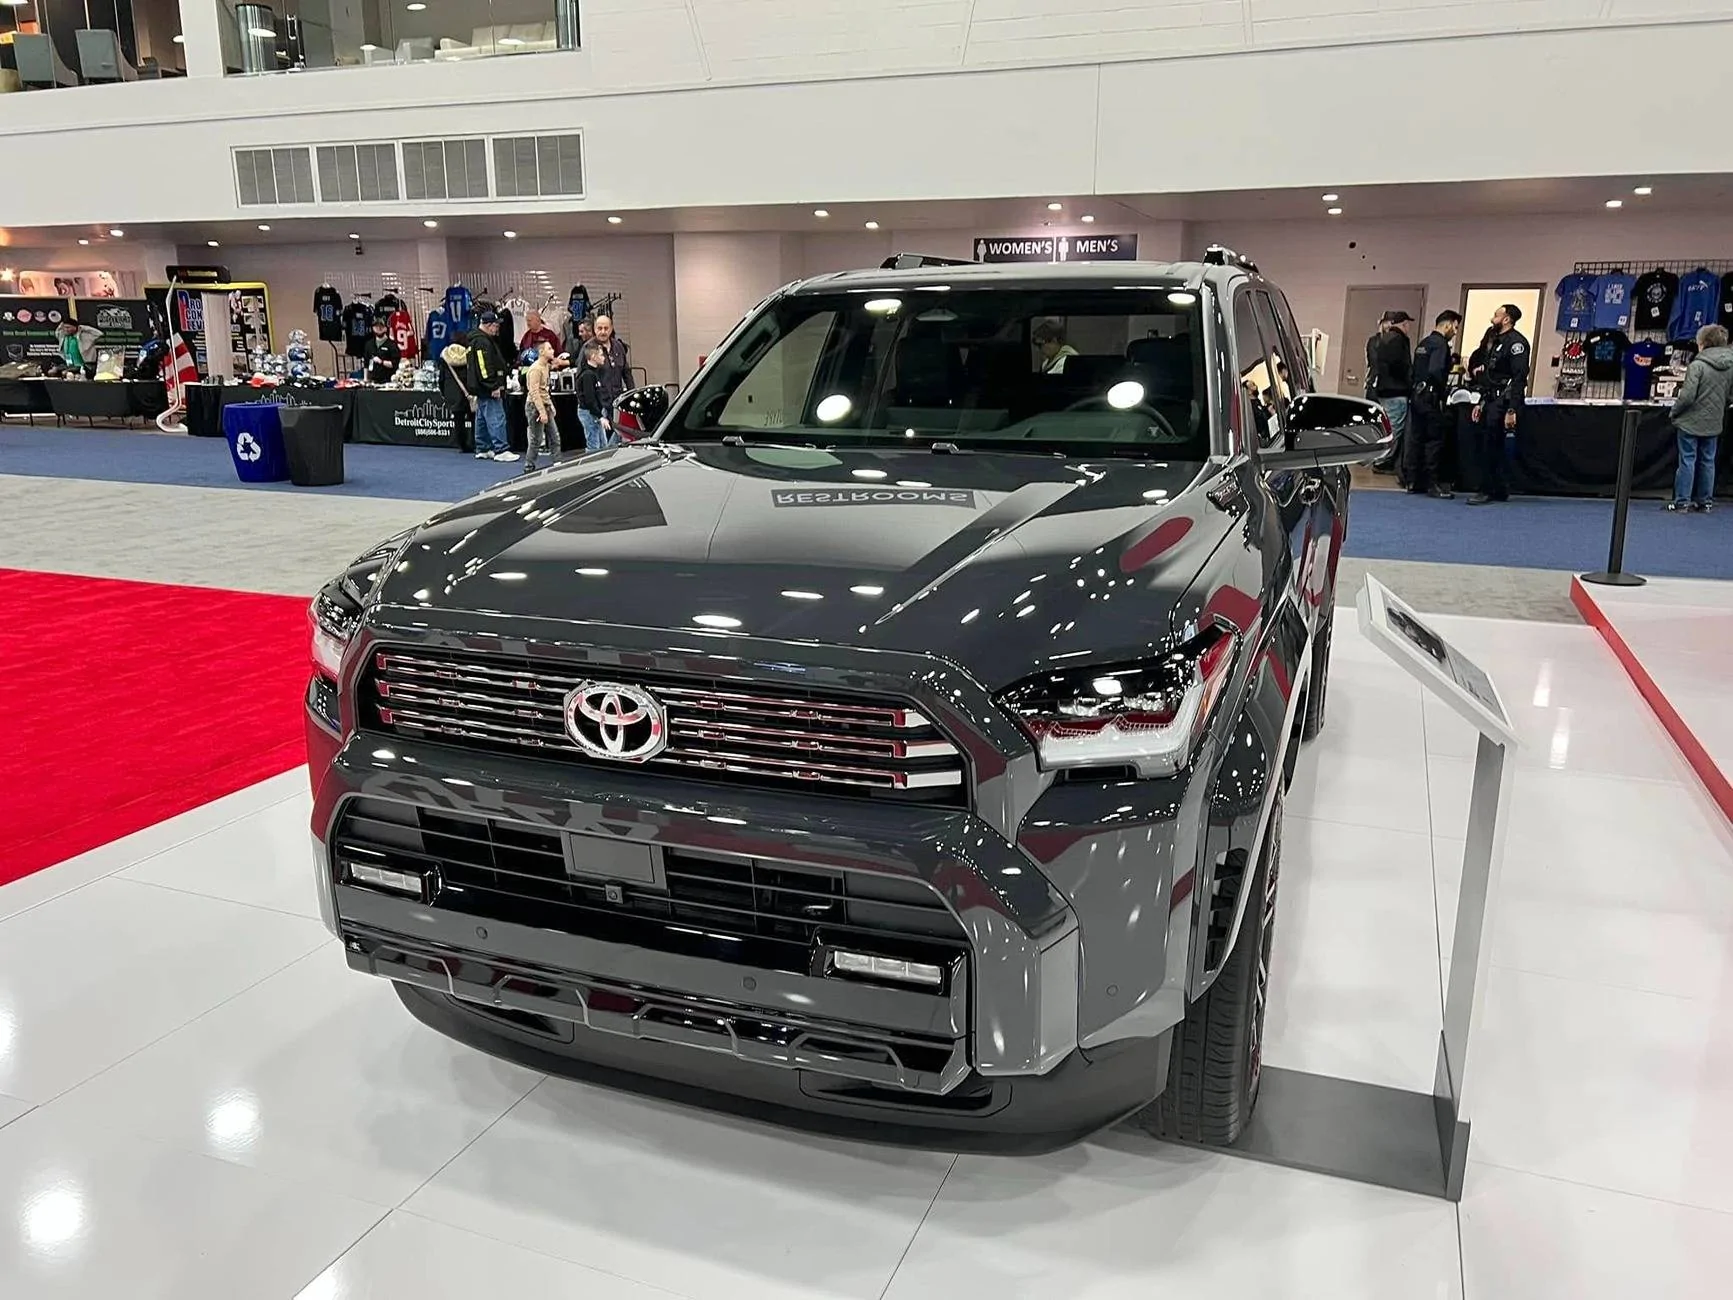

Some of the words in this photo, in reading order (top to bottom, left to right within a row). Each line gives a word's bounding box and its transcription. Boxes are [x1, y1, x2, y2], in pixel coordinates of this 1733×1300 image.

[989, 241, 1053, 255] WOMEN'S
[1076, 239, 1119, 253] MEN'S
[397, 329, 408, 350] 9
